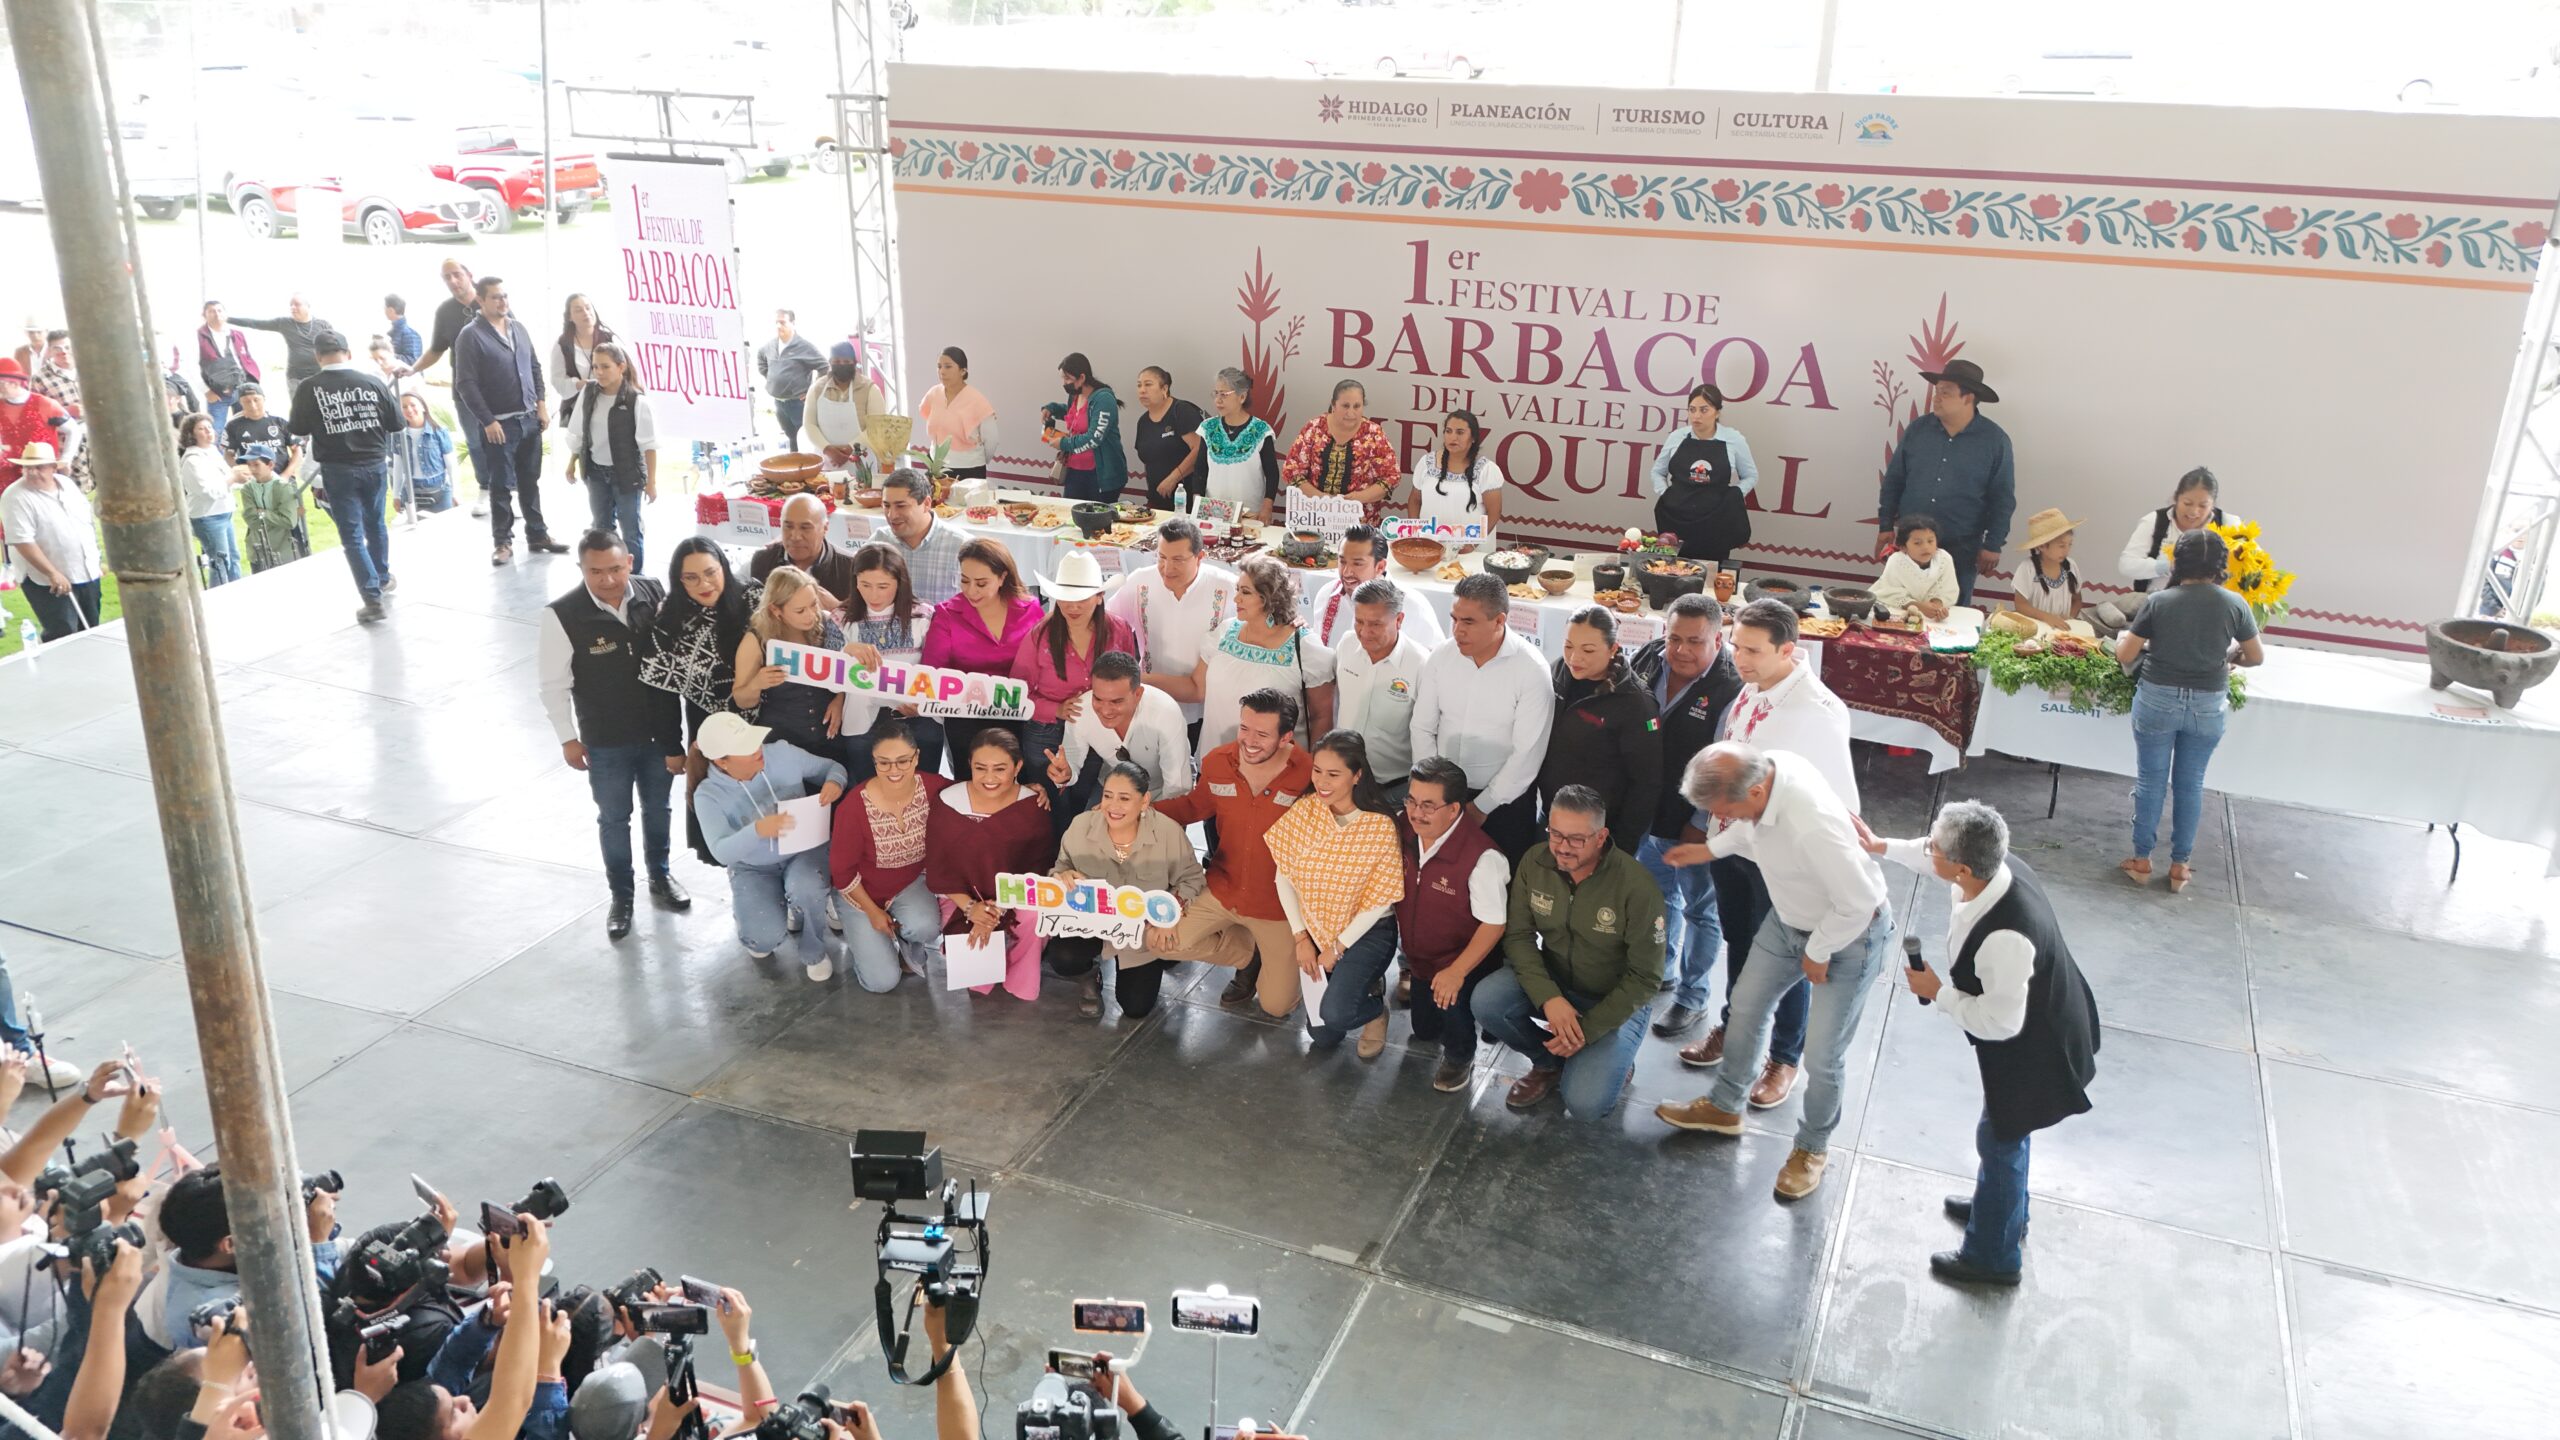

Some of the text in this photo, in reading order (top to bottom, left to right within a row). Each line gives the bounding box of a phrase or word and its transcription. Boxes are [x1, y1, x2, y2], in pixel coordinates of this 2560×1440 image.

[1348, 101, 1428, 116] HIDALGO
[1450, 102, 1572, 121] PLANEACIÓN
[1612, 108, 1706, 125] TURISMO
[1733, 112, 1829, 130] CULTURA
[645, 215, 704, 245] FESTIVAL DE
[622, 248, 737, 310] BARBACOA
[1449, 279, 1721, 326] FESTIVAL DE
[650, 311, 718, 340] DEL VALLE DEL
[1324, 306, 1840, 410] BARBACOA
[634, 342, 747, 405] MEZQUITAL
[320, 403, 354, 423] Bella
[1411, 384, 1690, 434] DEL VALLE DE
[324, 418, 381, 435] Huichapan
[1289, 511, 1326, 527] Bella
[1381, 516, 1488, 539] Cardonal
[736, 525, 765, 535] SALSA
[1534, 639, 1541, 647] 8
[773, 646, 1022, 710] HUICHAPAN
